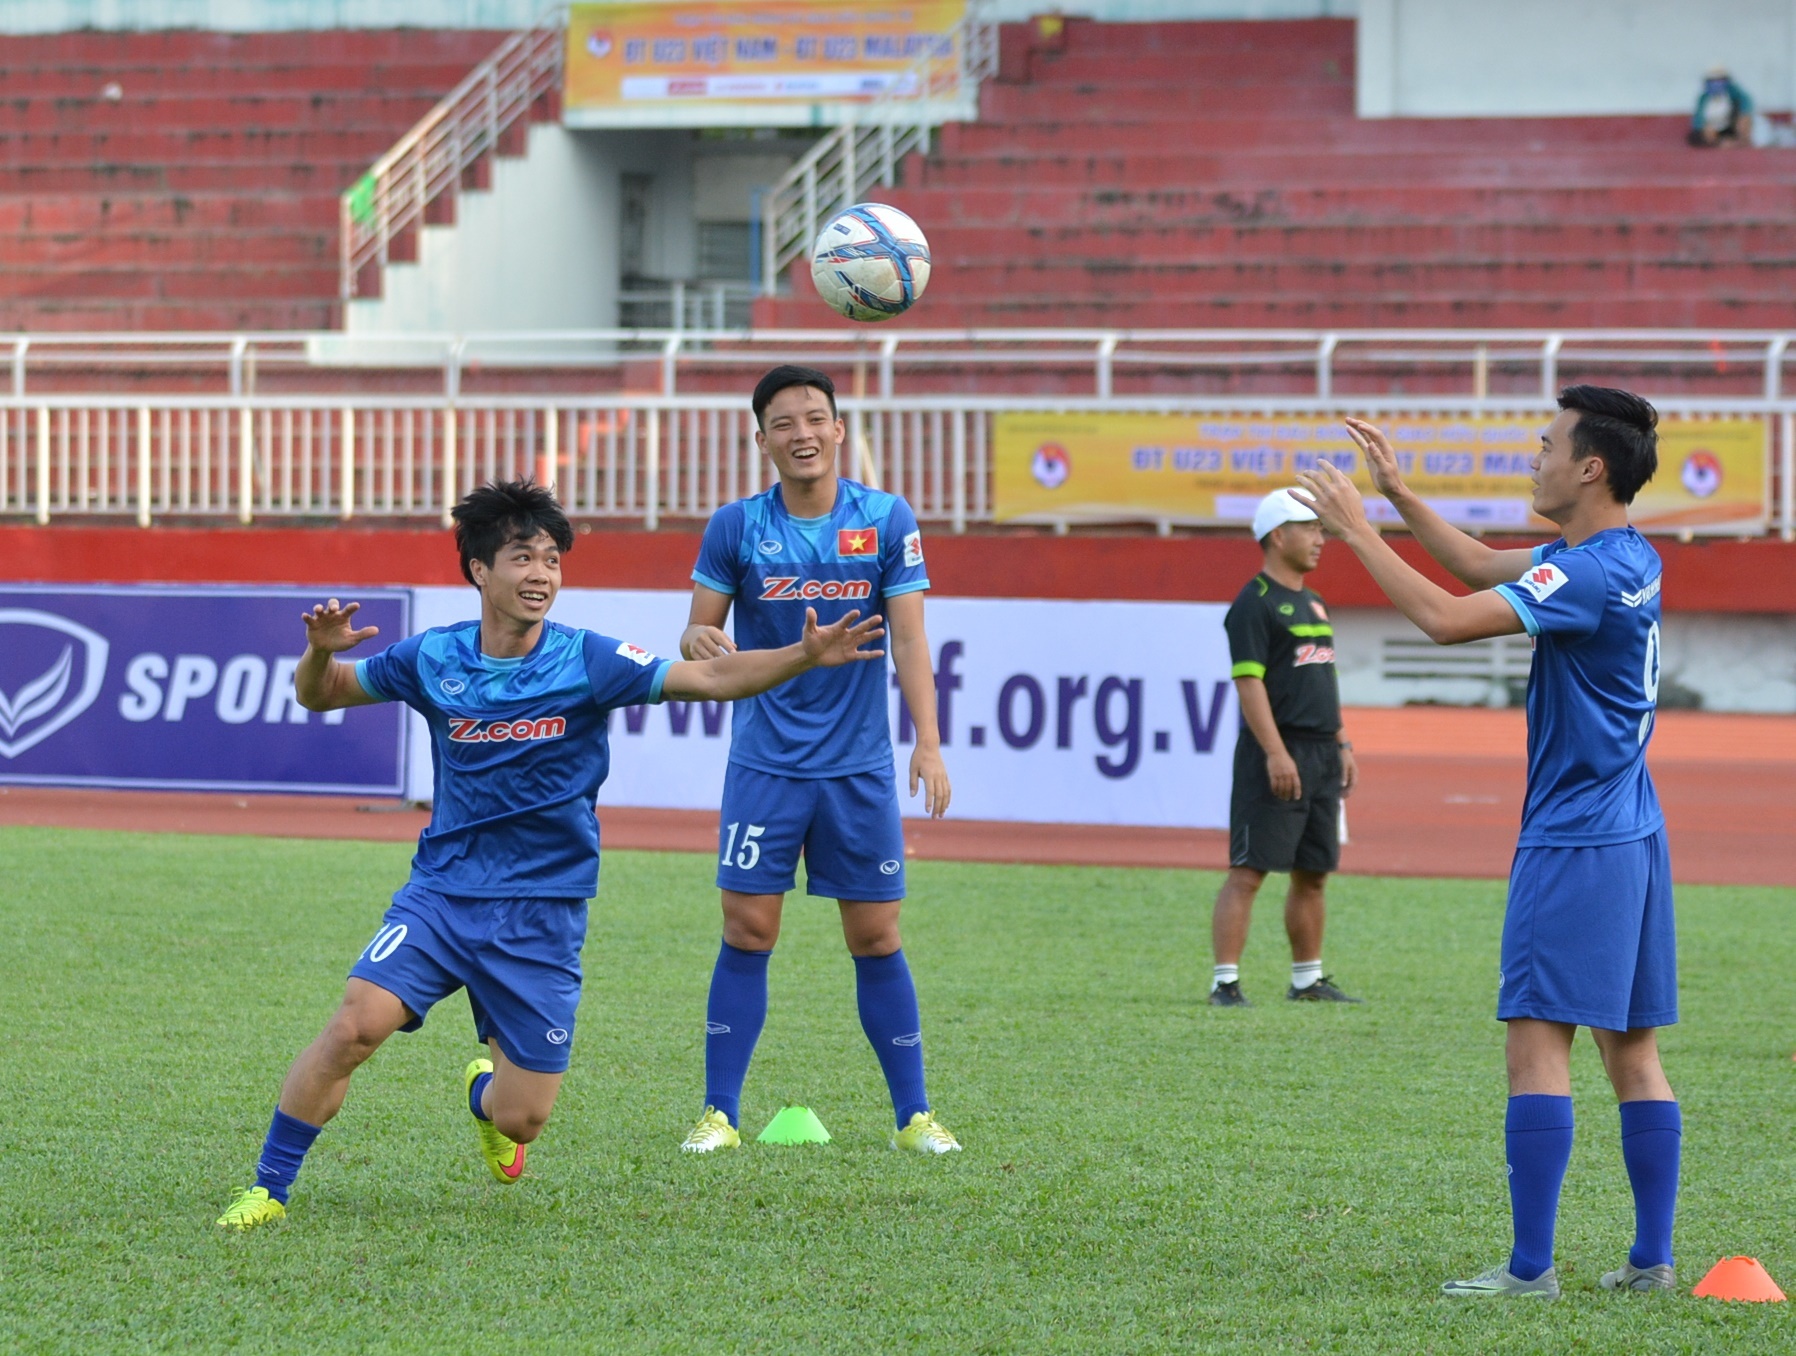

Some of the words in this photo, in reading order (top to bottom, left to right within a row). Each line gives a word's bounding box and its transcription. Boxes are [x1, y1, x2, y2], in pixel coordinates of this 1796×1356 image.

[653, 38, 686, 63] U23
[736, 37, 778, 62] NAM
[823, 36, 856, 60] U23
[1172, 447, 1223, 472] U23
[1232, 445, 1284, 477] VIỆT
[1424, 453, 1474, 475] U23
[758, 576, 872, 600] Z.com
[448, 716, 566, 743] Z.com
[721, 822, 766, 870] 15
[359, 922, 408, 963] 10
